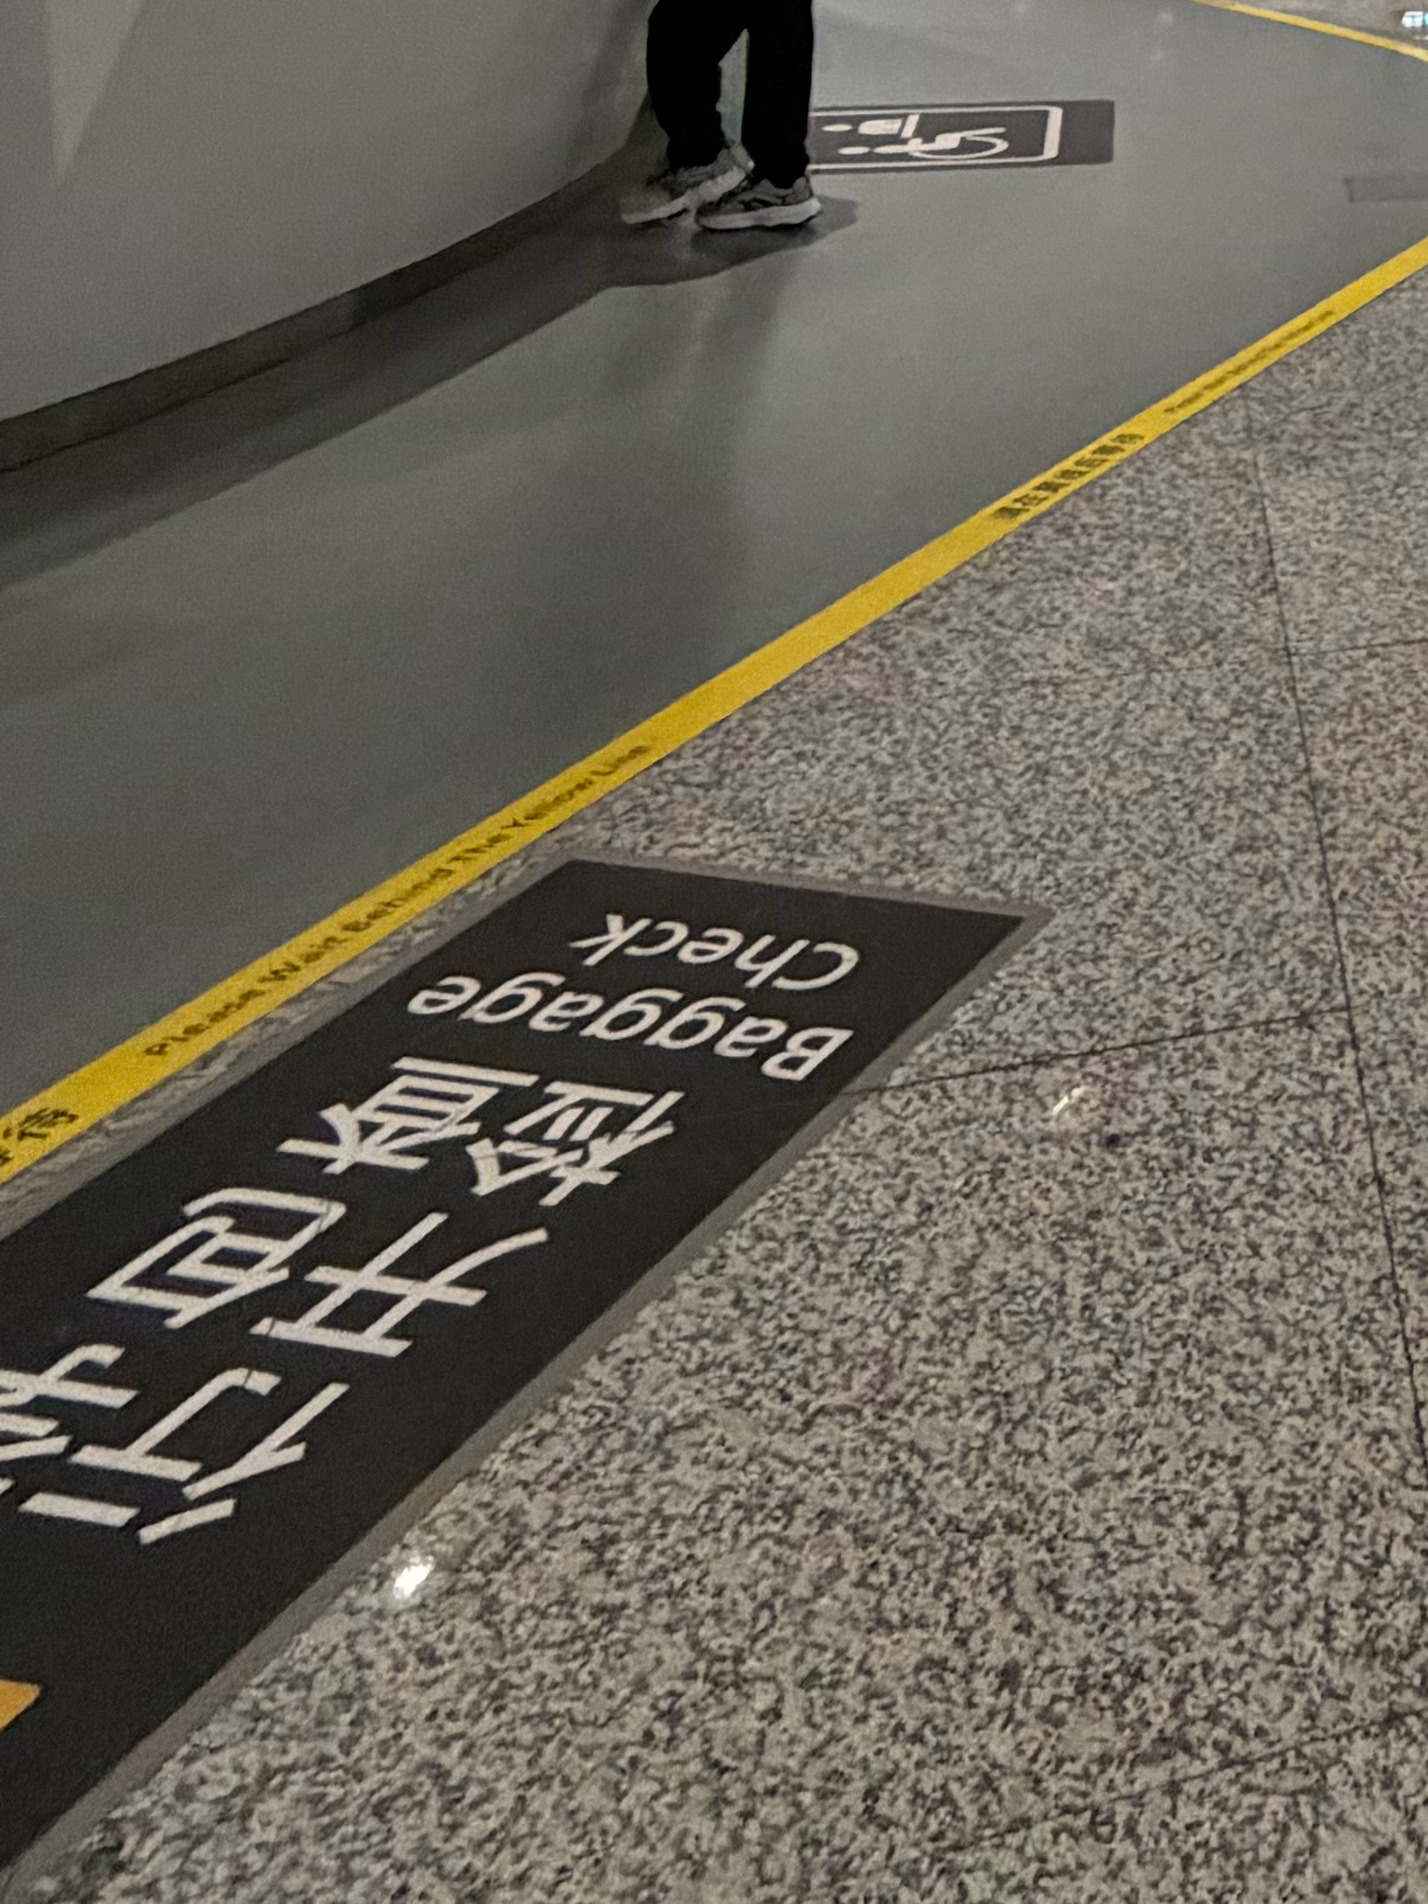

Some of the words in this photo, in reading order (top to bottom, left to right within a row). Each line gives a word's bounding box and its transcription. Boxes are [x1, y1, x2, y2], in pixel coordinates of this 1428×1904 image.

[145, 987, 267, 1060] Please
[264, 932, 346, 985] Wait
[347, 865, 455, 934] Behind
[451, 830, 513, 868] The
[500, 774, 594, 835] Yellow
[592, 743, 652, 778] Line
[569, 909, 862, 996] Check
[406, 972, 856, 1083] Baggage
[276, 1055, 687, 1208] 检查
[85, 1187, 549, 1359] 开包
